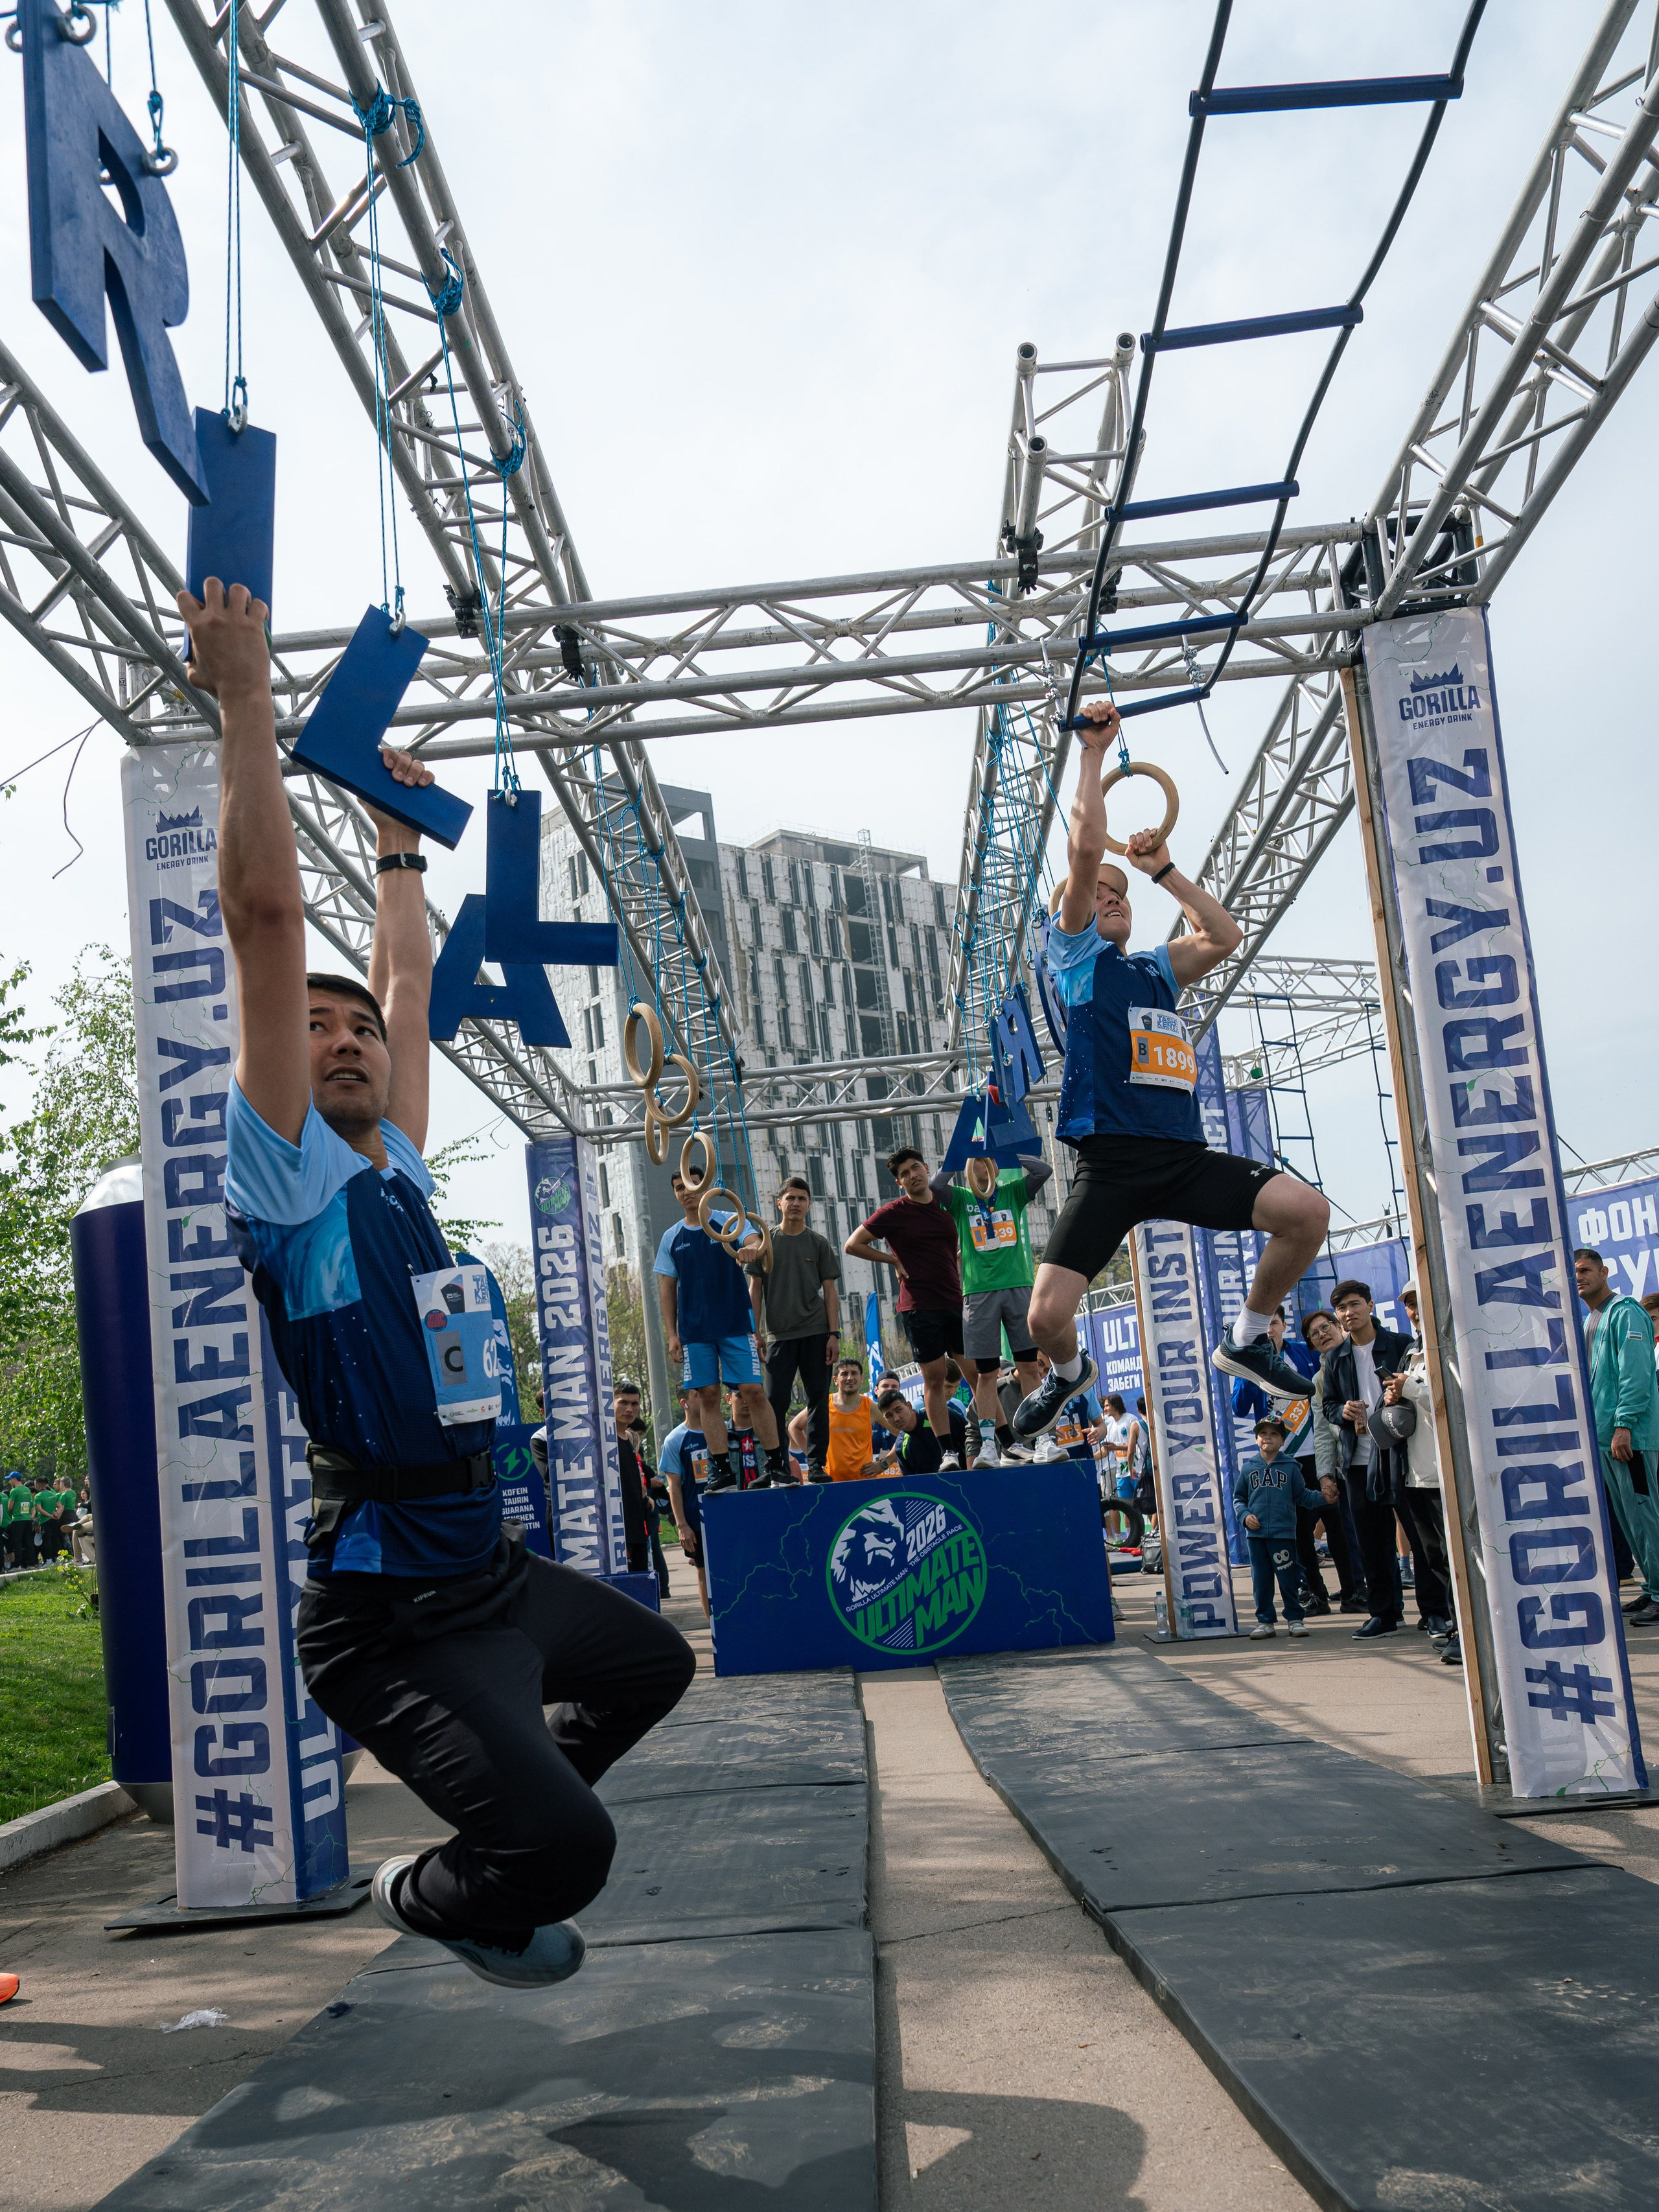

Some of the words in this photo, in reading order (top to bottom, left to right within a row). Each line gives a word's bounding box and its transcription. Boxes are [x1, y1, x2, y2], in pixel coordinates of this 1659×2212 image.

[1398, 685, 1481, 721] GORILLA
[1413, 716, 1446, 730] ENERGY
[1446, 712, 1473, 725] DRINK
[145, 827, 218, 861] GORILLA
[156, 857, 185, 871] ENERGY
[185, 854, 209, 866] DRINK
[1138, 1042, 1147, 1056] B
[1154, 1046, 1195, 1075] 1899
[983, 1226, 1014, 1239] 239
[1406, 747, 1616, 1725] #GORILLAENERGY.UZ
[1577, 1194, 1658, 1246] ФОН
[537, 1223, 583, 1331] 2026
[1102, 1314, 1137, 1354] ULT
[444, 1345, 464, 1373] C
[1106, 1355, 1143, 1376] КОМАНД
[547, 1344, 592, 1441] MAN
[585, 1213, 627, 1574] RILLAENERGY.UZ
[1108, 1373, 1141, 1393] ЗАБЕГИ
[1157, 1339, 1207, 1458] YOUR
[881, 1467, 901, 1475] 882
[1249, 1469, 1288, 1491] GAP
[502, 1487, 528, 1497] KOFEIN
[503, 1496, 529, 1506] TAURIN
[906, 1503, 947, 1563] 2026
[1171, 1472, 1227, 1629] POWER
[846, 1597, 872, 1612] GORILLA
[871, 1579, 897, 1600] ULTIMATE
[909, 1556, 921, 1567] THE
[920, 1533, 947, 1557] OBSTACLE
[946, 1524, 964, 1537] RACE
[413, 1590, 437, 1603] KIPRUN
[855, 1536, 980, 1643] ULTIMATE
[914, 1566, 982, 1648] MAN
